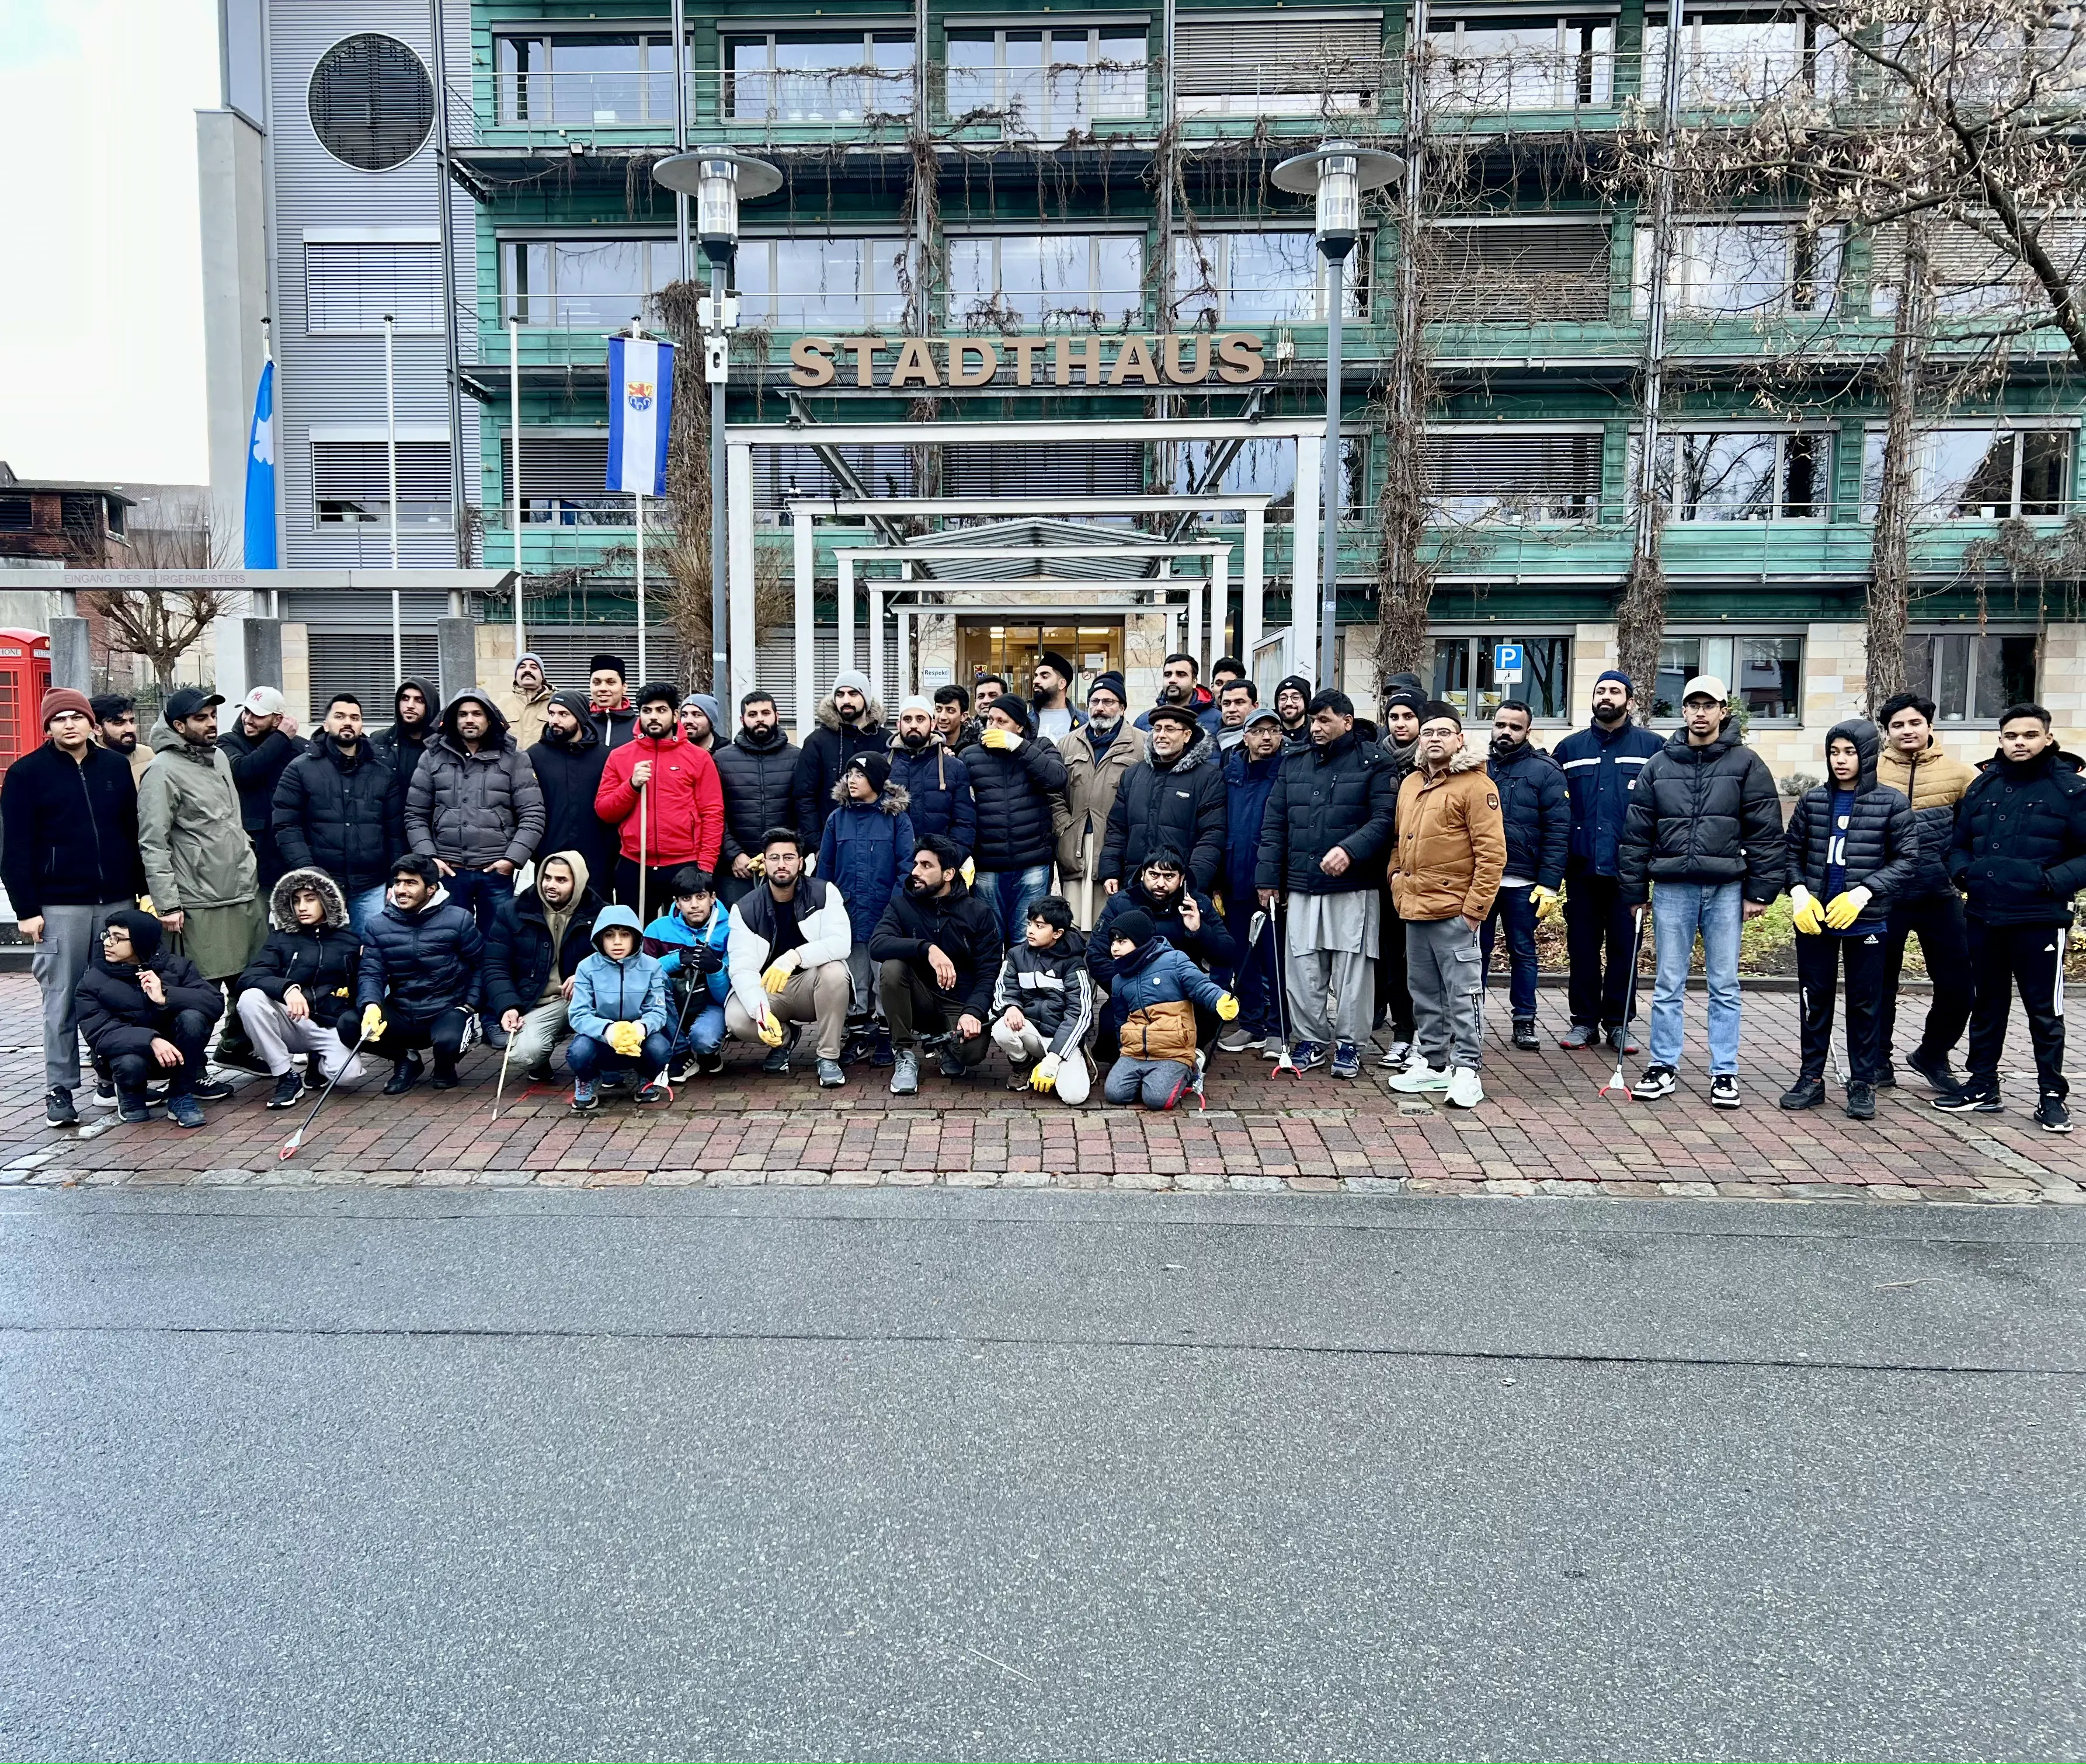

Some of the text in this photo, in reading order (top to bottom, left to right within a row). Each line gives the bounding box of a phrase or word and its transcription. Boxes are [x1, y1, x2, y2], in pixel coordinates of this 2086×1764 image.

[788, 333, 1264, 387] STADTHAUS
[64, 574, 245, 583] EINGANG DES BÜRGERMEISTERS
[1501, 648, 1516, 669] P
